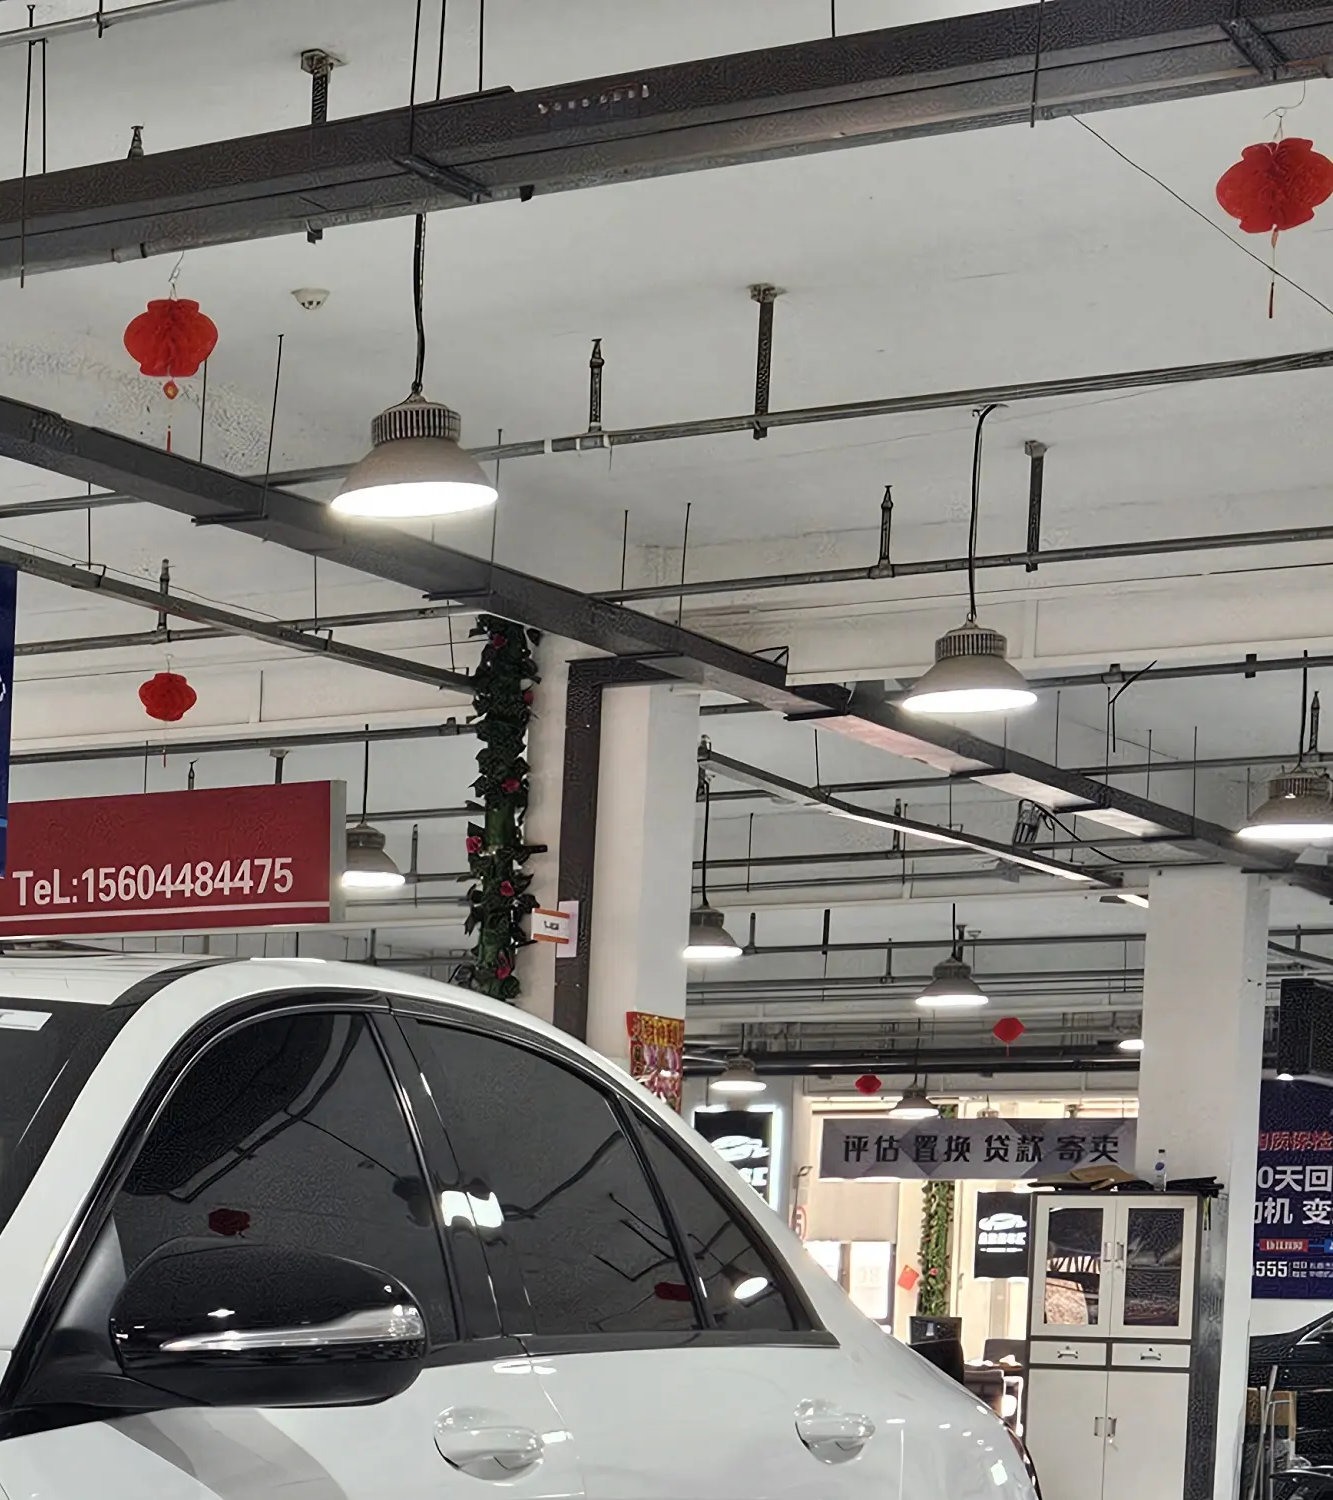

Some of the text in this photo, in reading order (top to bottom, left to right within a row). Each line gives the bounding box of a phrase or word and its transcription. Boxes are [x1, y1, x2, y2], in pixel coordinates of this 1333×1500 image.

[843, 1134, 1119, 1163] 评估 置换 贷款 寄卖
[1302, 1197, 1333, 1225] 变
[1252, 1260, 1288, 1278] 555
